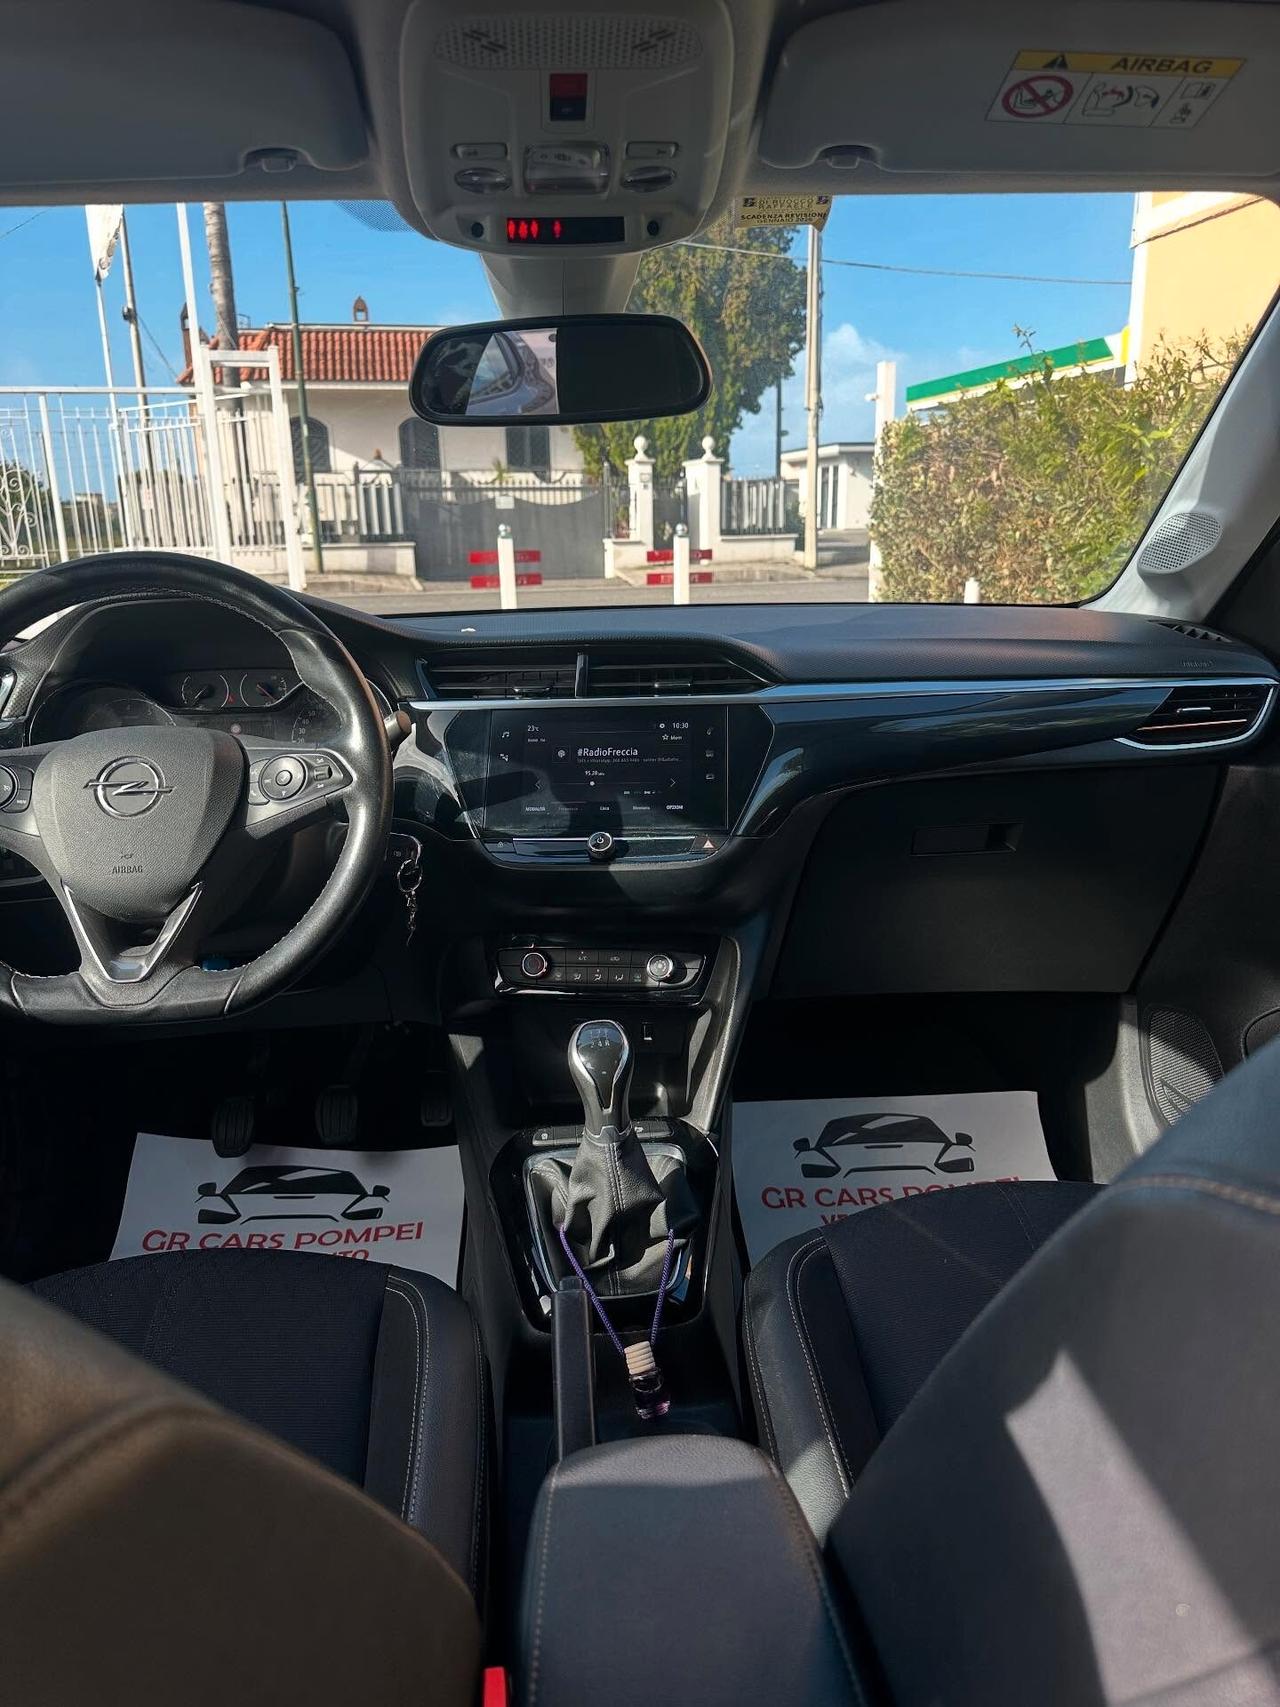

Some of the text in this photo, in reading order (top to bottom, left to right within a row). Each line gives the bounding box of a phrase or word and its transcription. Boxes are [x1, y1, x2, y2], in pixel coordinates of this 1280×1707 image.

[1110, 57, 1213, 73] AIRBAG
[577, 747, 639, 757] #RadioFreccia
[111, 865, 143, 875] AIRBAG
[761, 1184, 807, 1209] GR
[814, 1186, 895, 1208] CARS
[141, 1221, 424, 1251] GR CARS POMPEI
